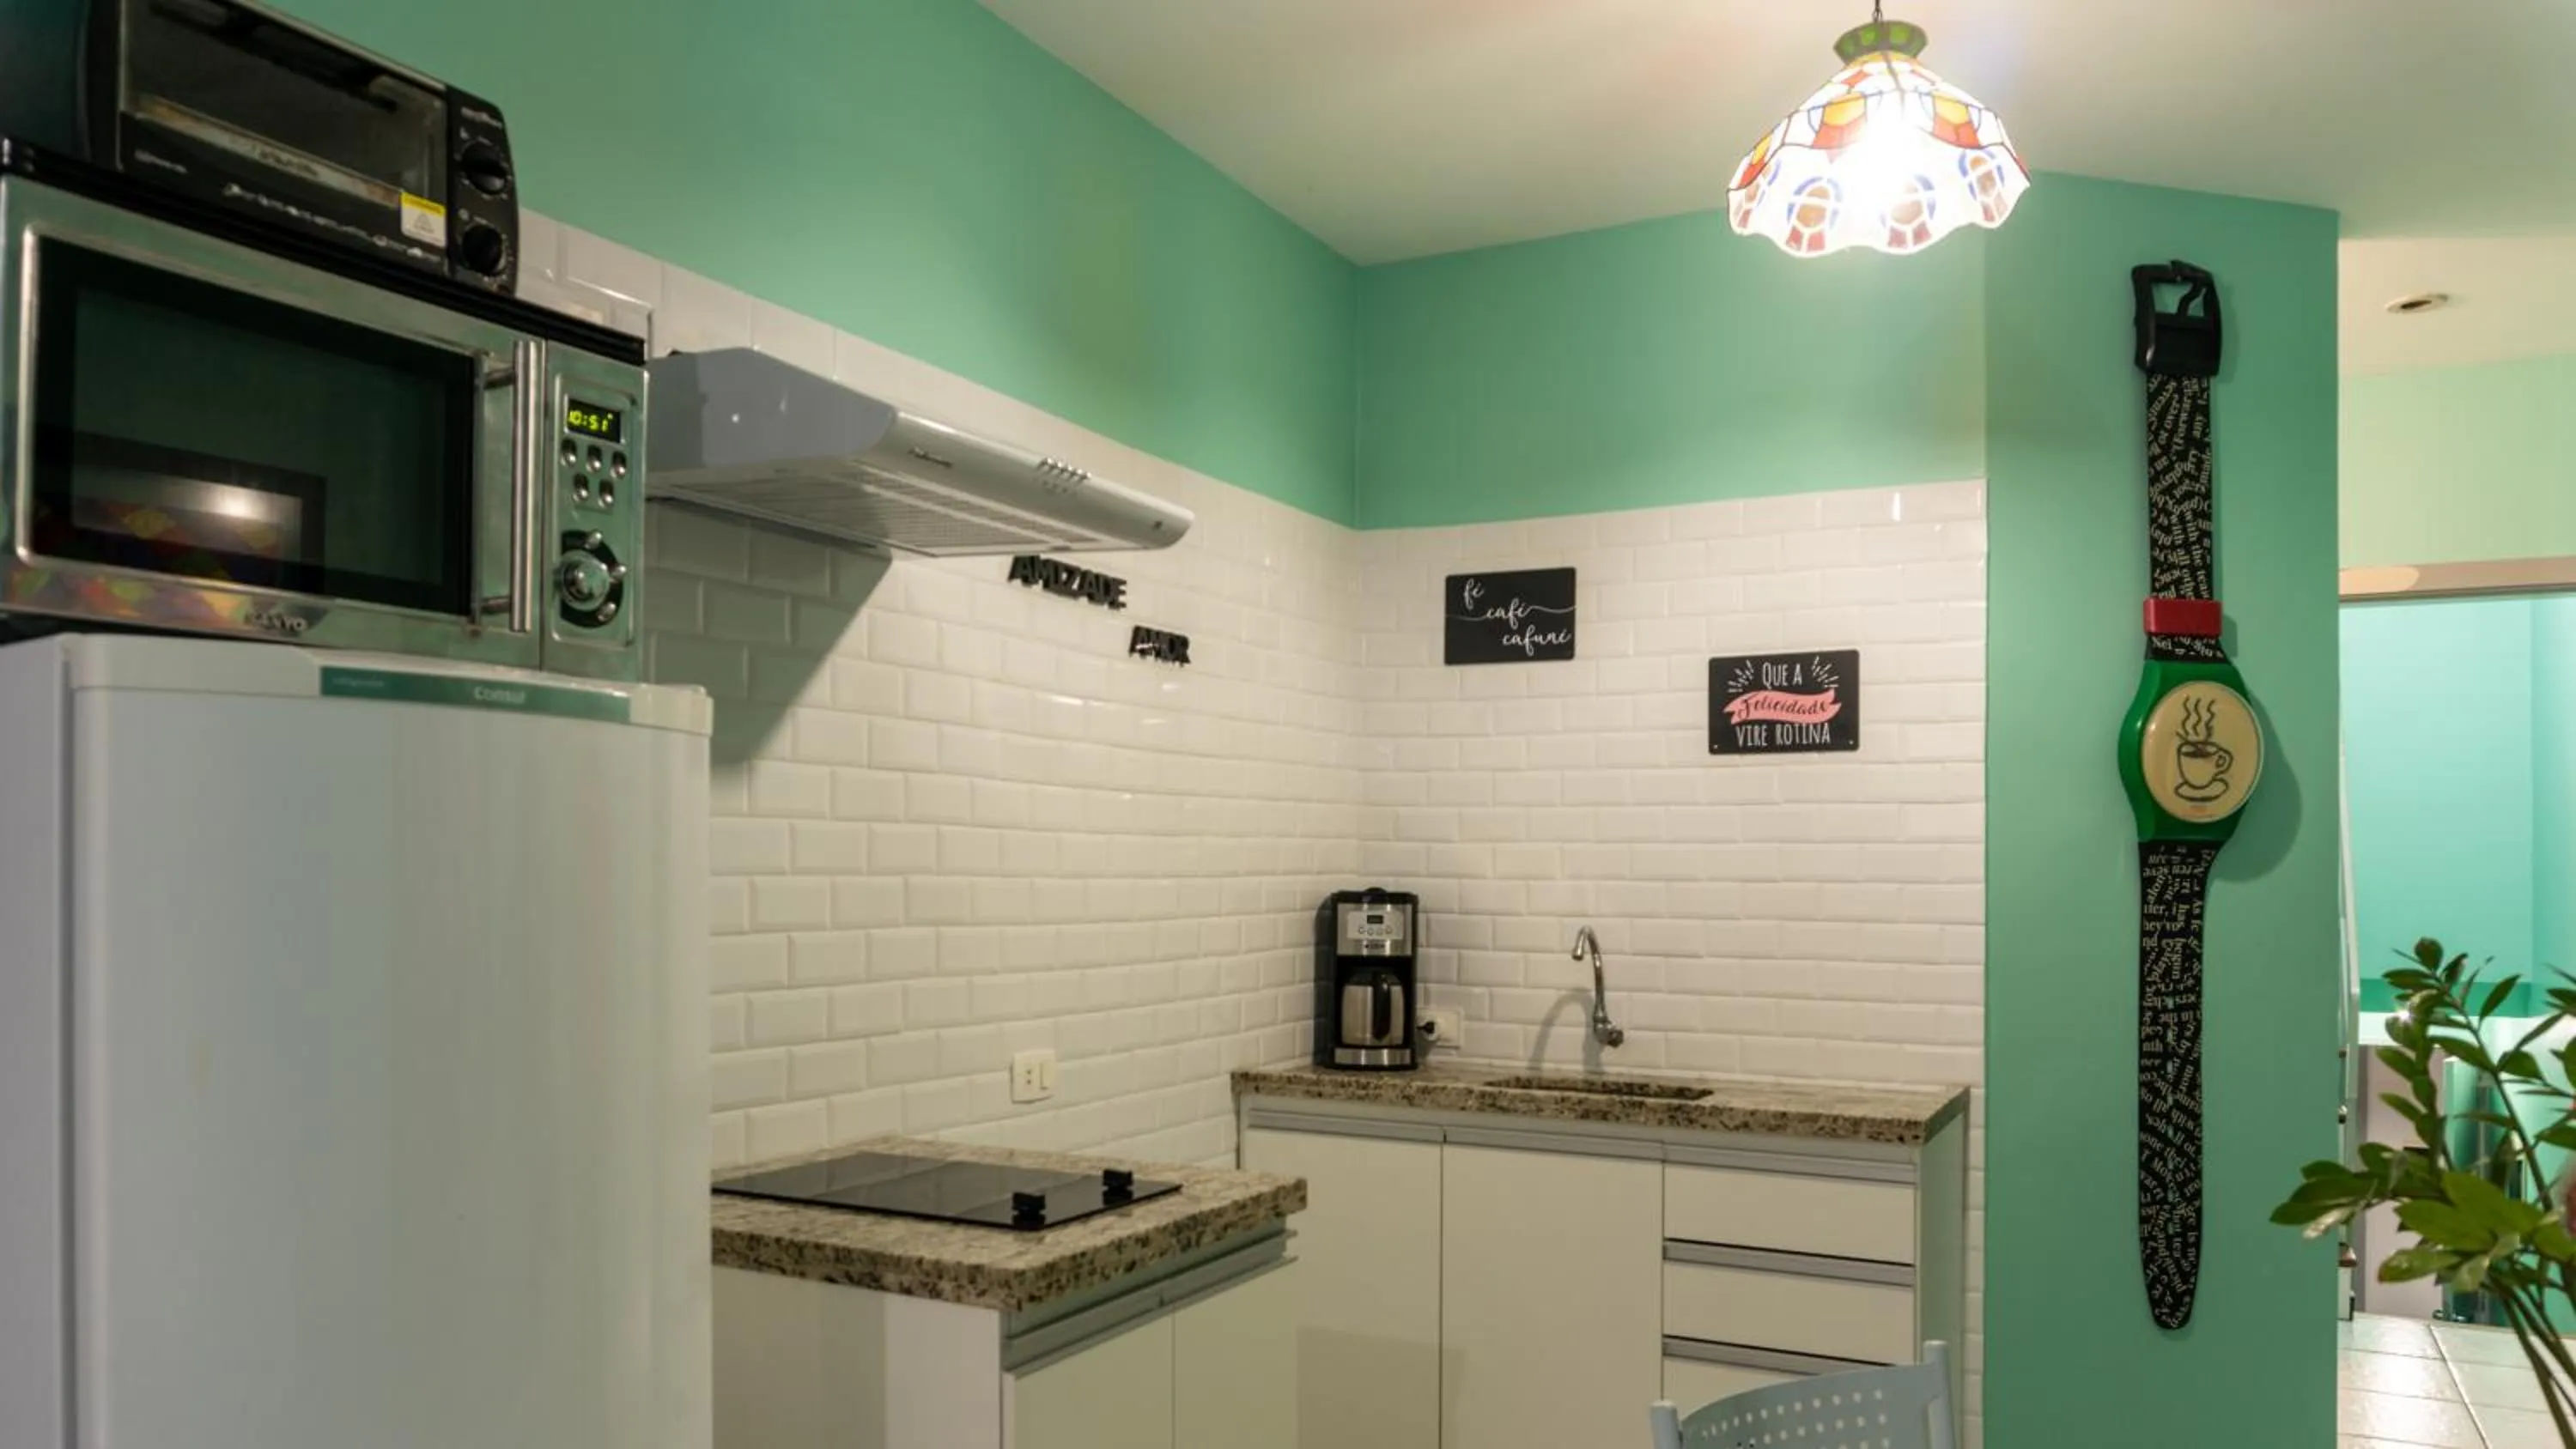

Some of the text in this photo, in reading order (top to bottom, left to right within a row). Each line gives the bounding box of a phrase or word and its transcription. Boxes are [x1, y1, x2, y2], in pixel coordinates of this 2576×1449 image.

[1008, 555, 1127, 610] AMIZADE
[1463, 579, 1484, 609] fé
[1485, 599, 1528, 629] café
[1128, 625, 1190, 667] AMOR
[1502, 624, 1571, 656] cafuné
[1761, 662, 1803, 690] QUE A
[1737, 696, 1829, 719] Felicidade
[1736, 722, 1831, 747] VIRE ROTINA
